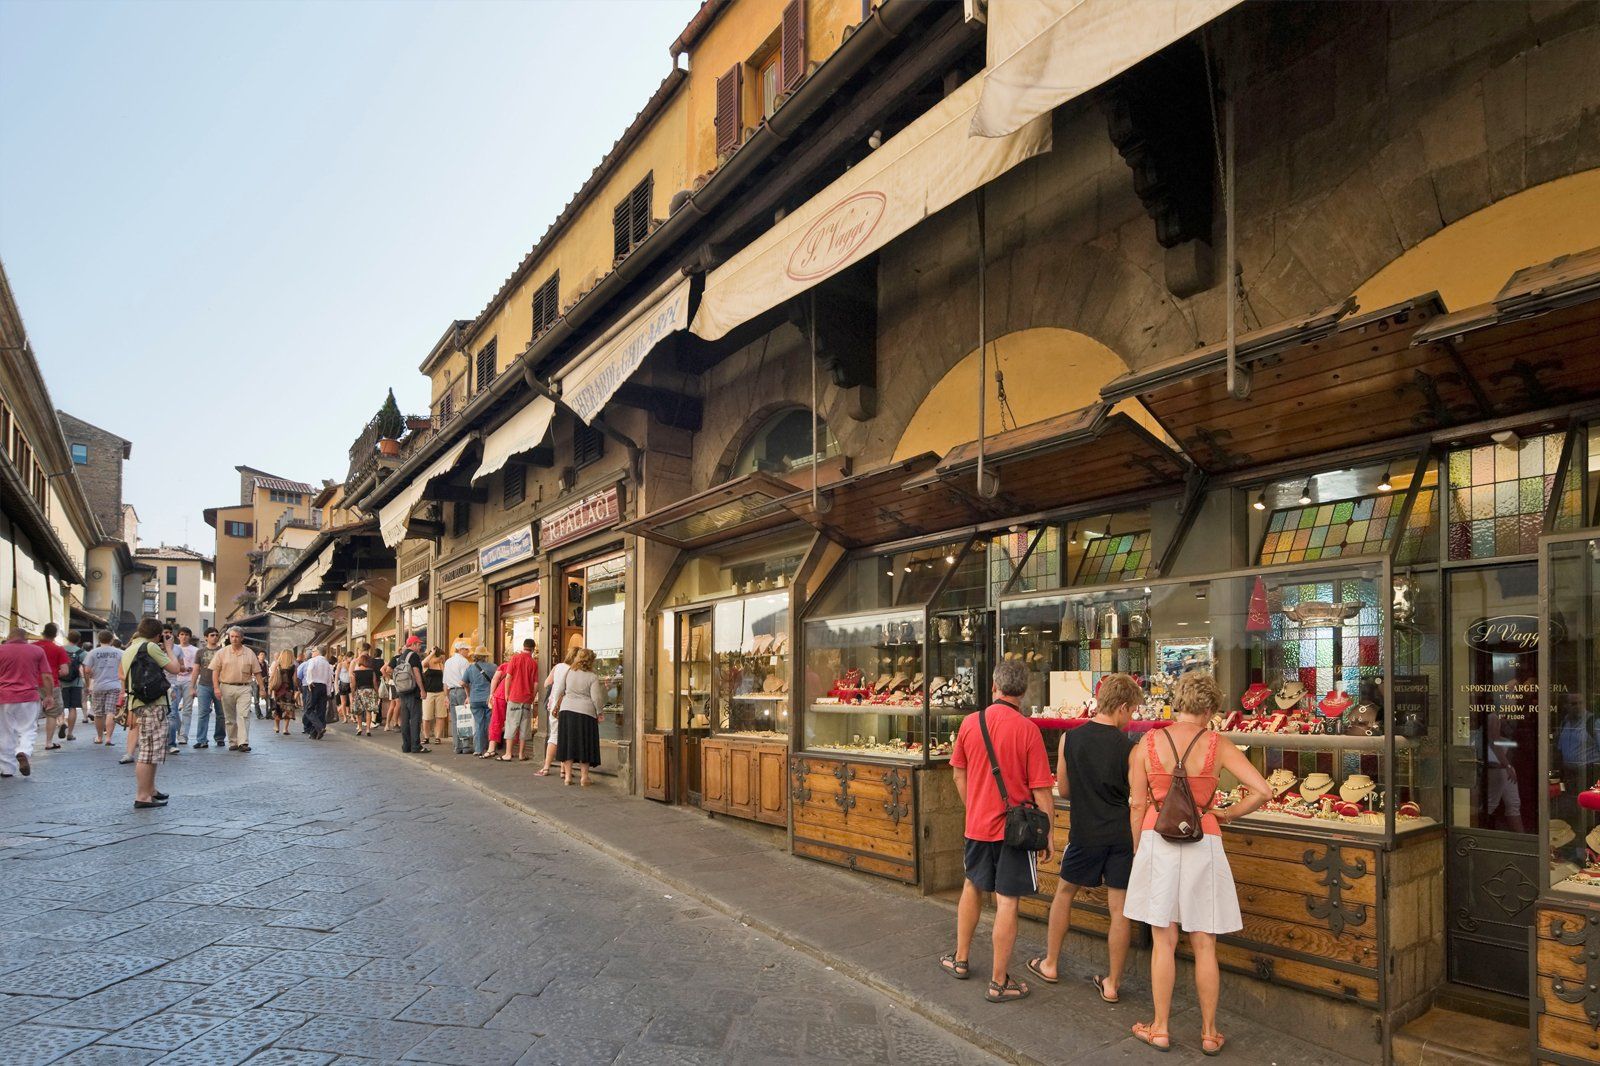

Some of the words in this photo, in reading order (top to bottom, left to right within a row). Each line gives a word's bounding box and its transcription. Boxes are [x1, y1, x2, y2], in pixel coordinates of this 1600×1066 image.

[1496, 623, 1541, 648] Vagg
[1460, 684, 1509, 693] ESPOSIZIONE
[1513, 684, 1569, 693] ARGENERIA
[1469, 704, 1496, 713] SILVER
[1499, 704, 1526, 713] SHOW
[1528, 704, 1558, 713] ROM
